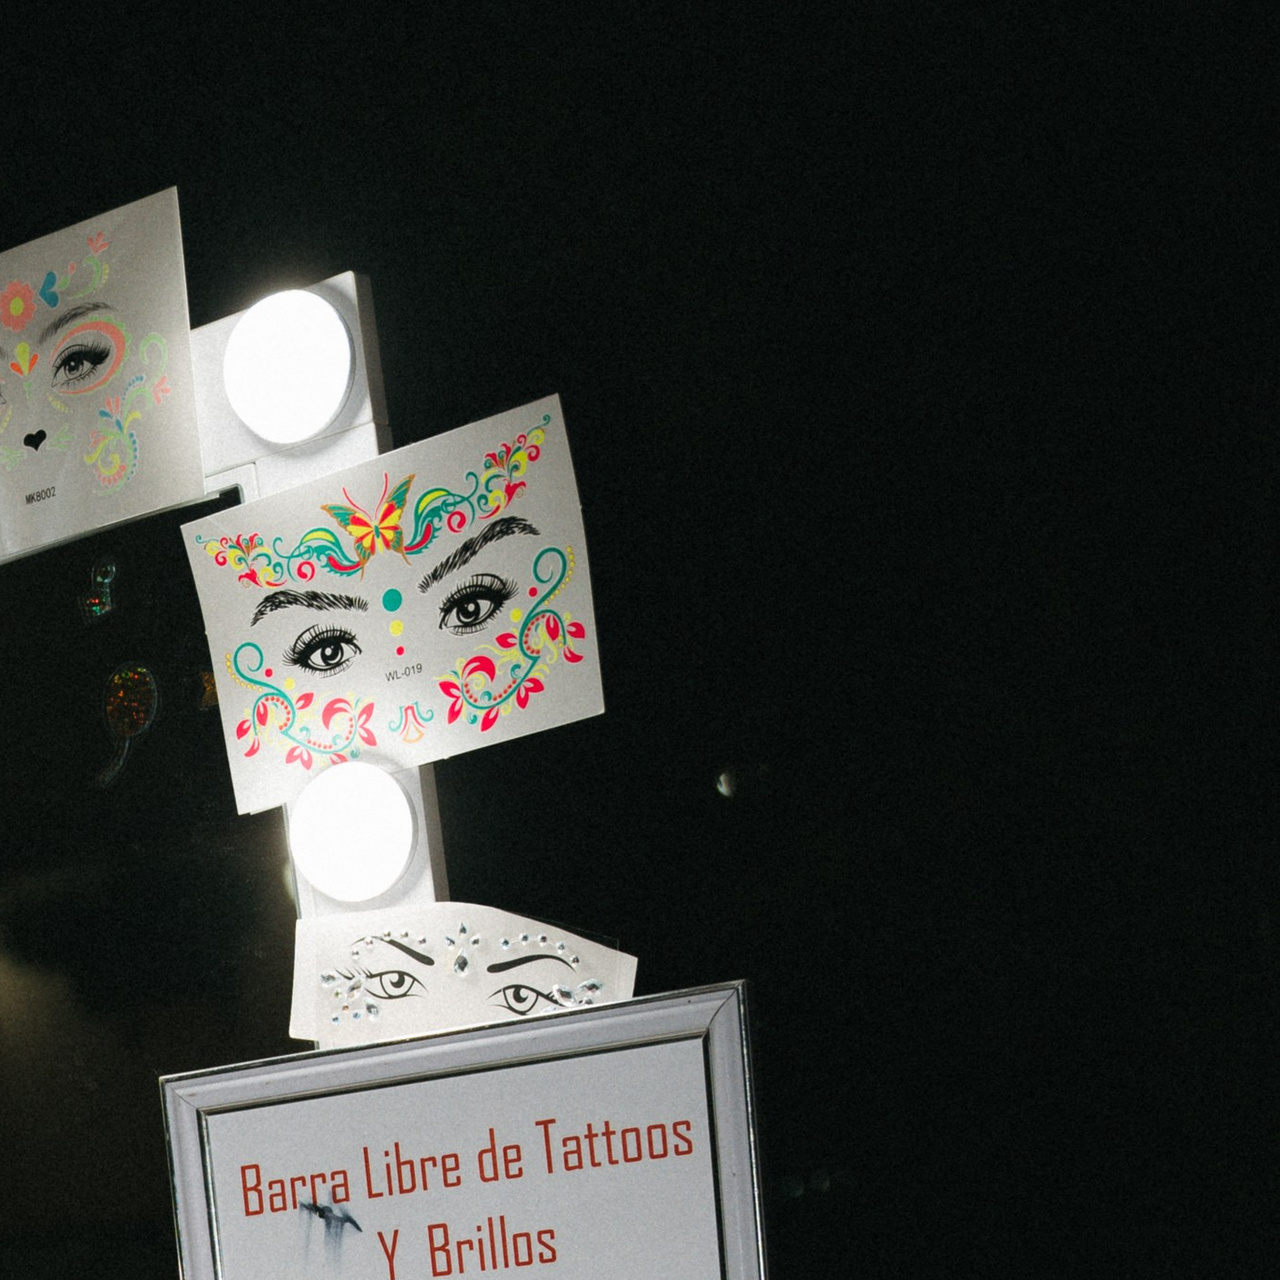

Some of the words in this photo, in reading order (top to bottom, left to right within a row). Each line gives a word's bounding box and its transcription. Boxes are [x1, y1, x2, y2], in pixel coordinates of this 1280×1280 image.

[25, 486, 56, 505] MK8002
[385, 663, 423, 682] WL-019
[239, 1163, 352, 1217] Barra
[362, 1141, 462, 1199] Libre
[476, 1127, 524, 1184] de
[534, 1118, 694, 1174] Tattoos
[427, 1214, 558, 1278] Brillos
